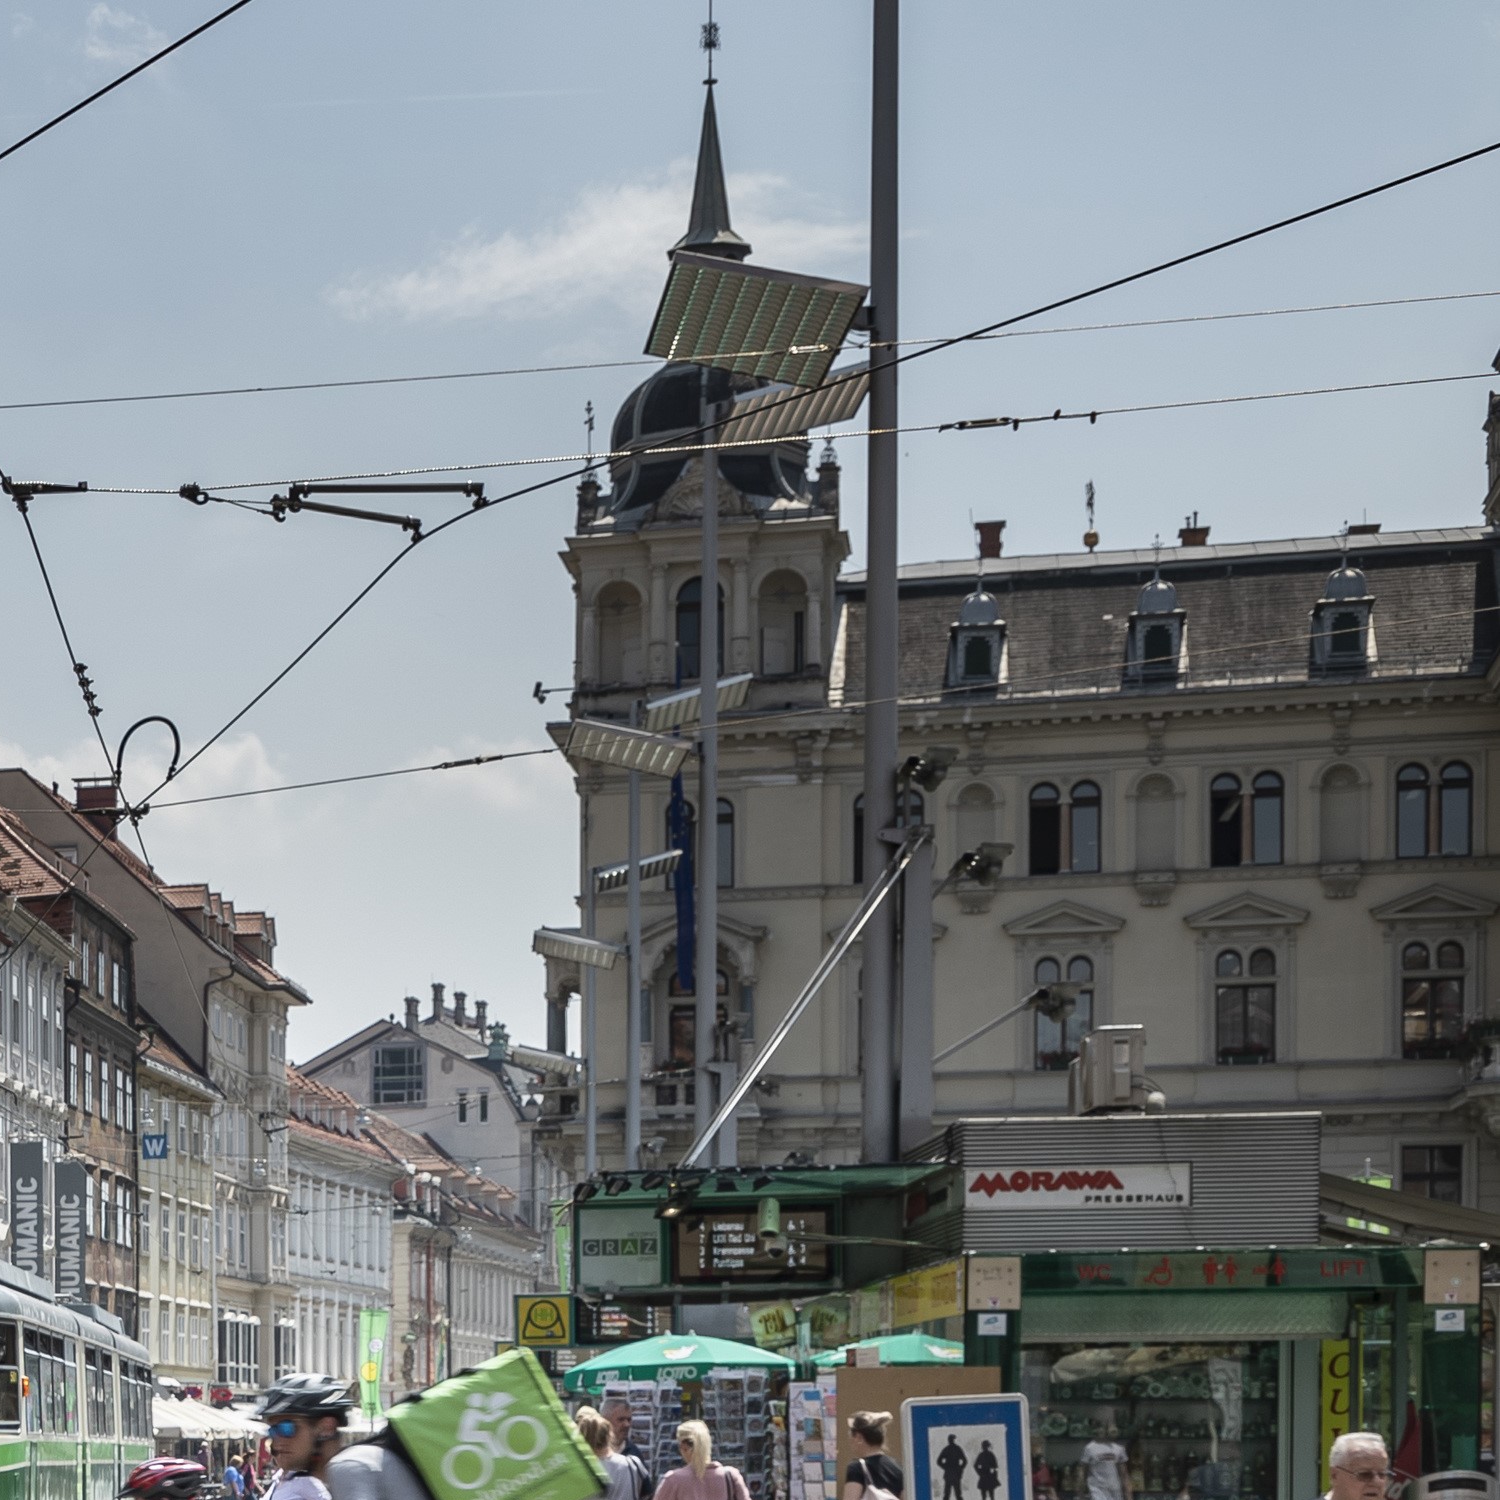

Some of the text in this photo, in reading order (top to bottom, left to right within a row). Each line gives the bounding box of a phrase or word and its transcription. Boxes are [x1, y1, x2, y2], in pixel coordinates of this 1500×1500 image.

[145, 1138, 165, 1156] W
[968, 1171, 1124, 1198] MORAWA
[1084, 1194, 1184, 1204] PRESSEHAUS
[16, 1176, 38, 1276] UMANIC
[583, 1240, 657, 1256] GRAZ
[1077, 1263, 1112, 1281] WC
[1320, 1259, 1366, 1278] LIFT
[656, 1366, 698, 1380] LOTTO
